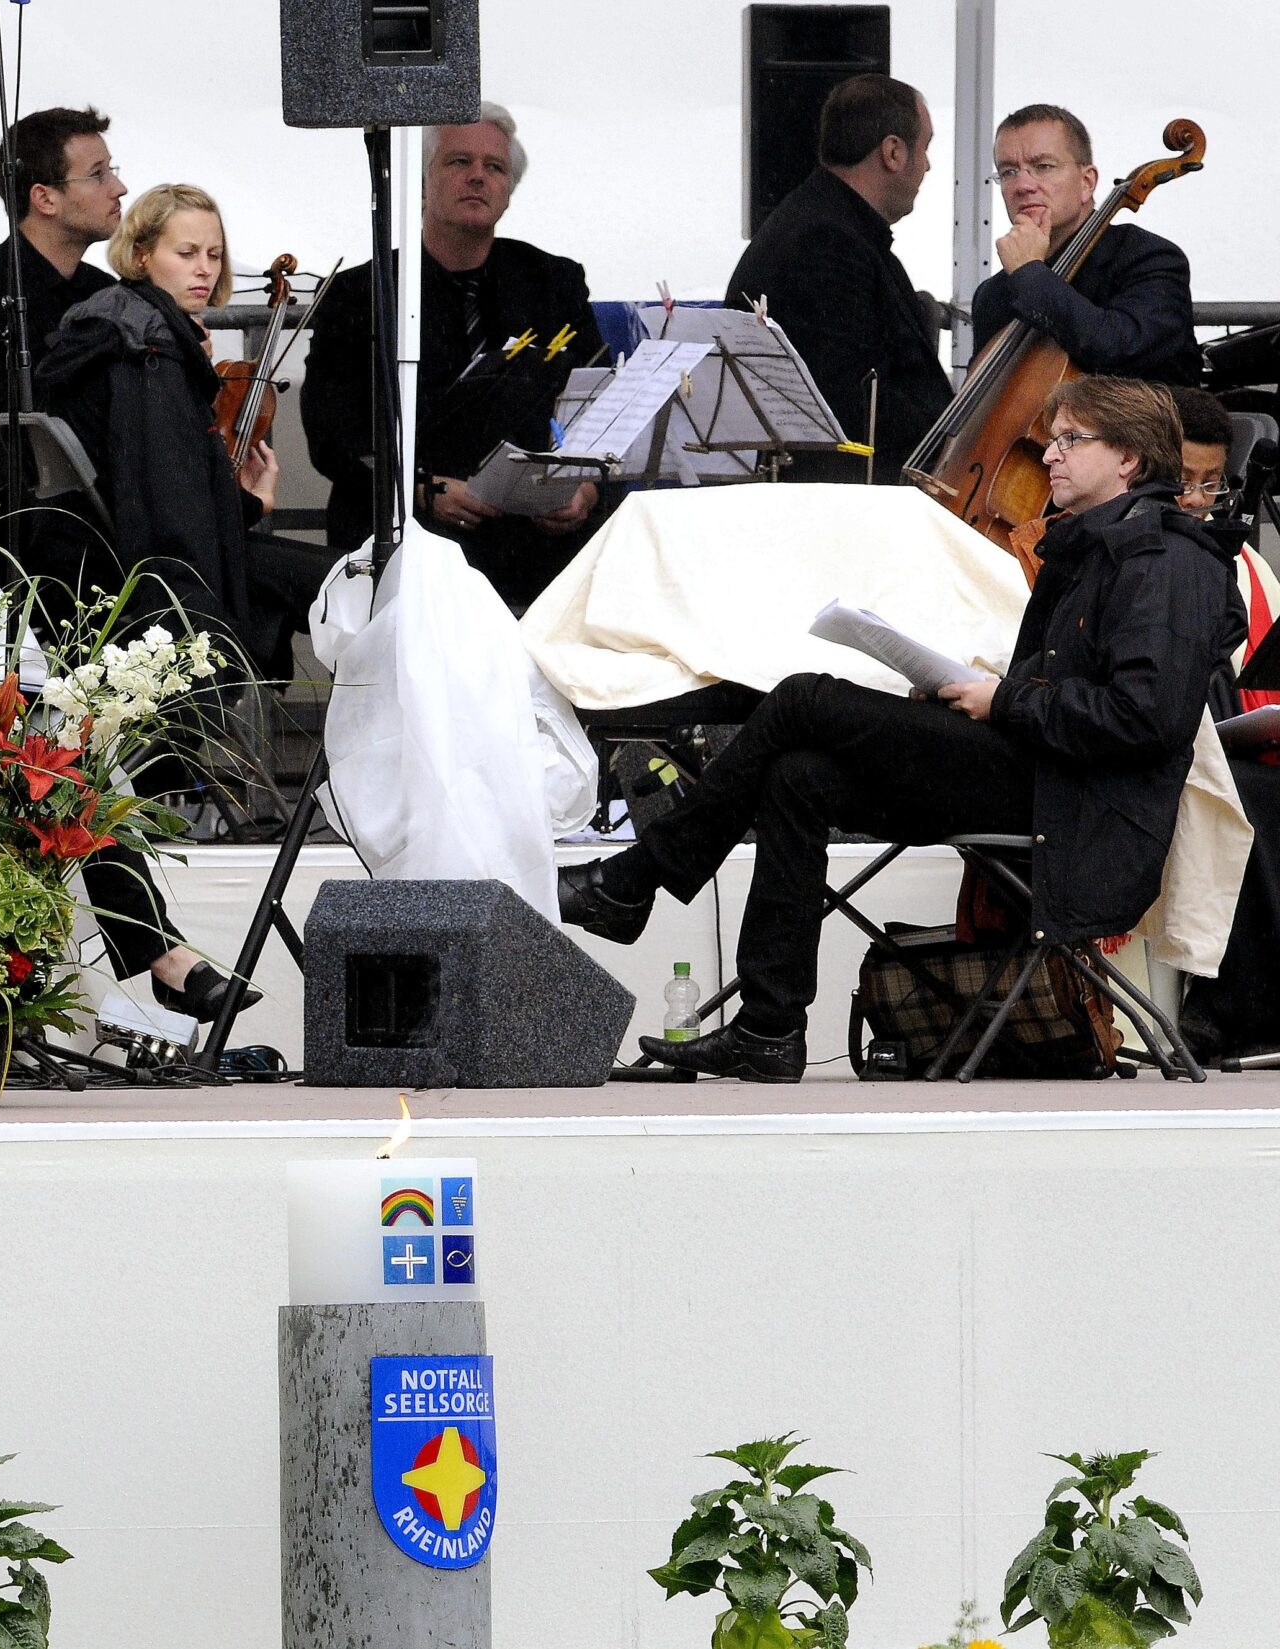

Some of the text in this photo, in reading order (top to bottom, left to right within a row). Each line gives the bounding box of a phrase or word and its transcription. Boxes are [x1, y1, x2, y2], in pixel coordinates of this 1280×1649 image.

[401, 1369, 483, 1390] NOTFALL
[384, 1392, 489, 1414] SEELSORGE
[392, 1505, 491, 1559] RHEINLAND
